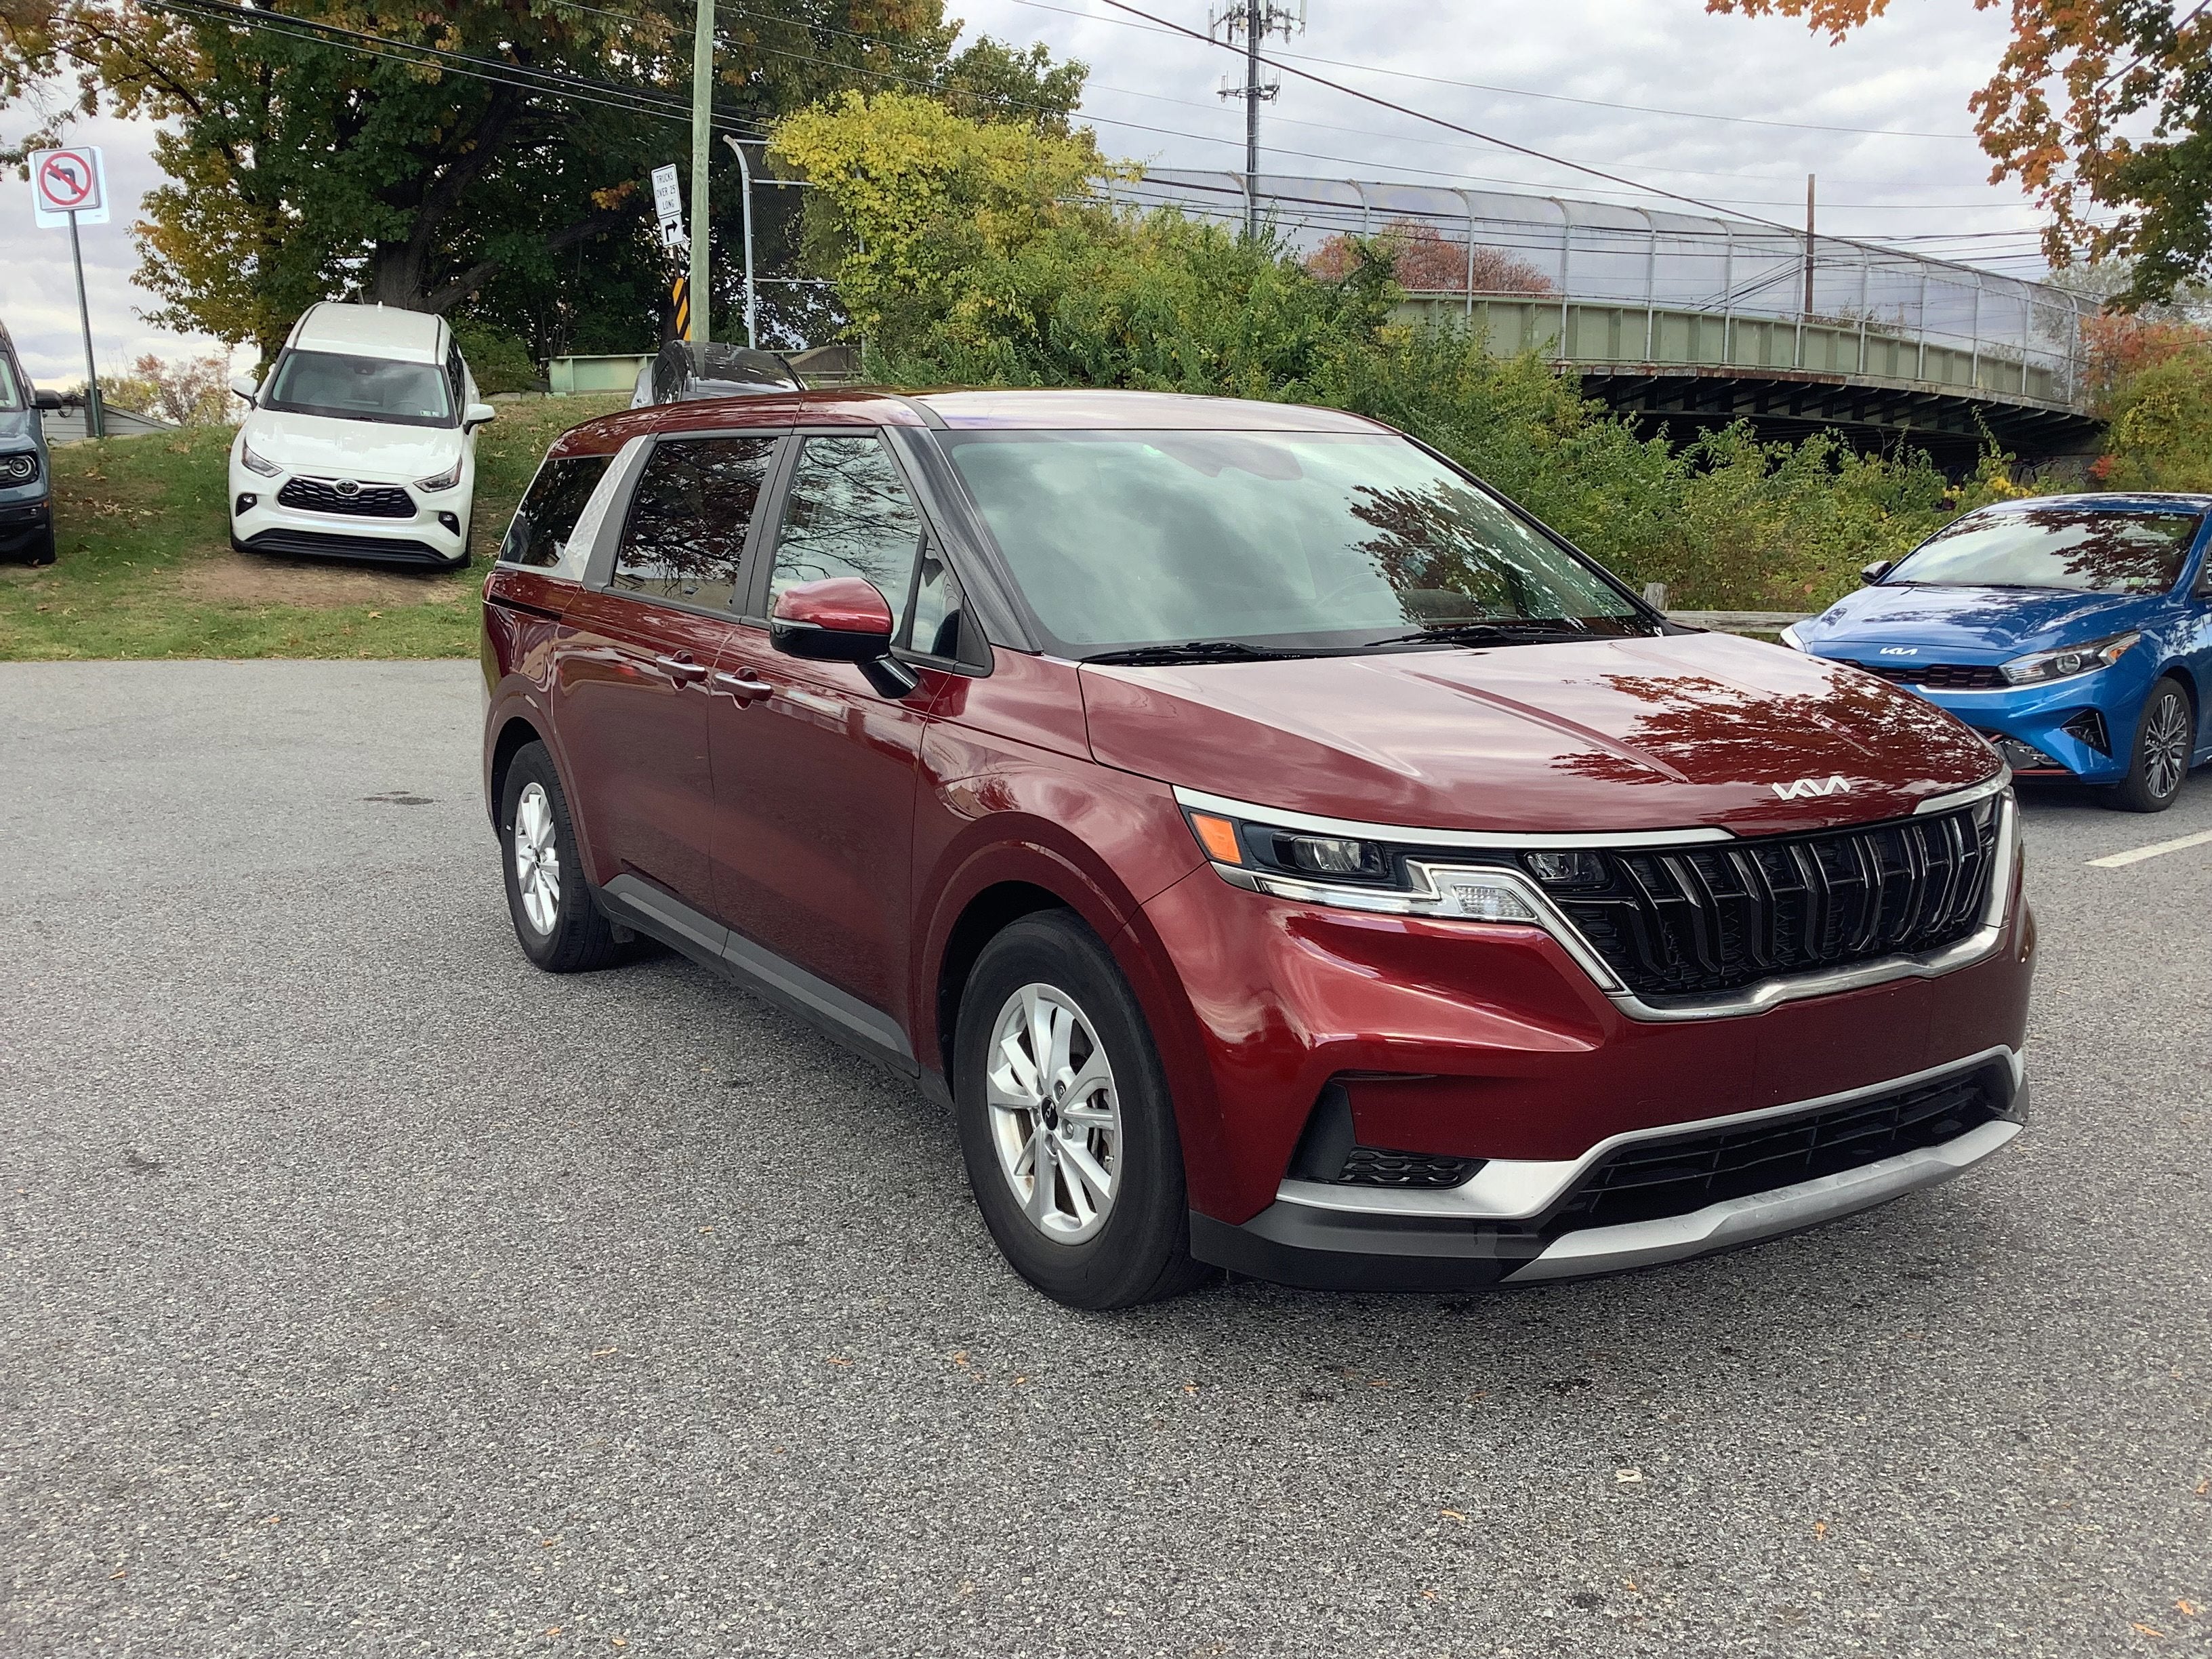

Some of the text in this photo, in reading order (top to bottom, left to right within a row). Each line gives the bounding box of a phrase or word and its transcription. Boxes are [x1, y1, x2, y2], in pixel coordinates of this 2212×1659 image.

[656, 171, 674, 184] TRUCKS
[656, 187, 668, 198] OVER
[662, 199, 674, 210] LONG
[1879, 647, 1918, 655] KIA
[1771, 775, 1851, 800] KIA
